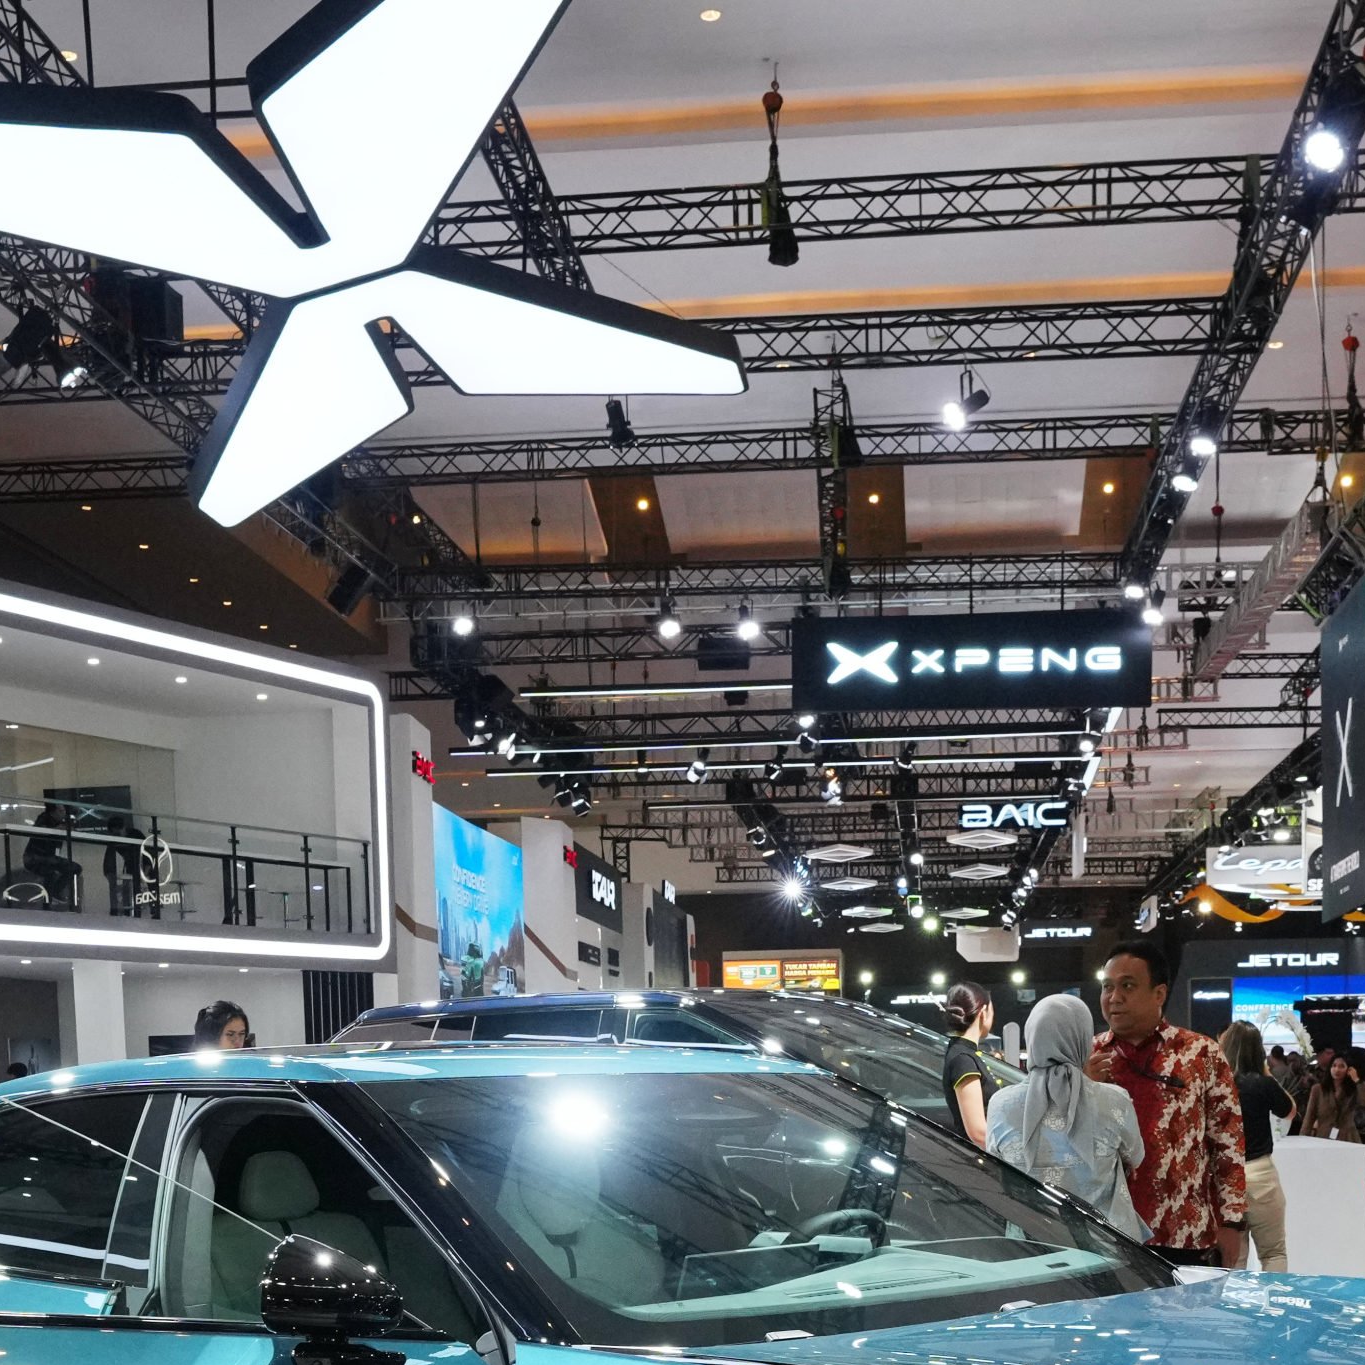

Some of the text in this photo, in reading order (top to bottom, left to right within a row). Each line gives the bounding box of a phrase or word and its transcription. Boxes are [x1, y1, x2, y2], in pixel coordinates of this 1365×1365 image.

[911, 646, 1122, 673] XPENG
[962, 801, 1069, 828] BAIC
[1024, 927, 1092, 938] JETOUR
[1237, 952, 1340, 968] JETOUR
